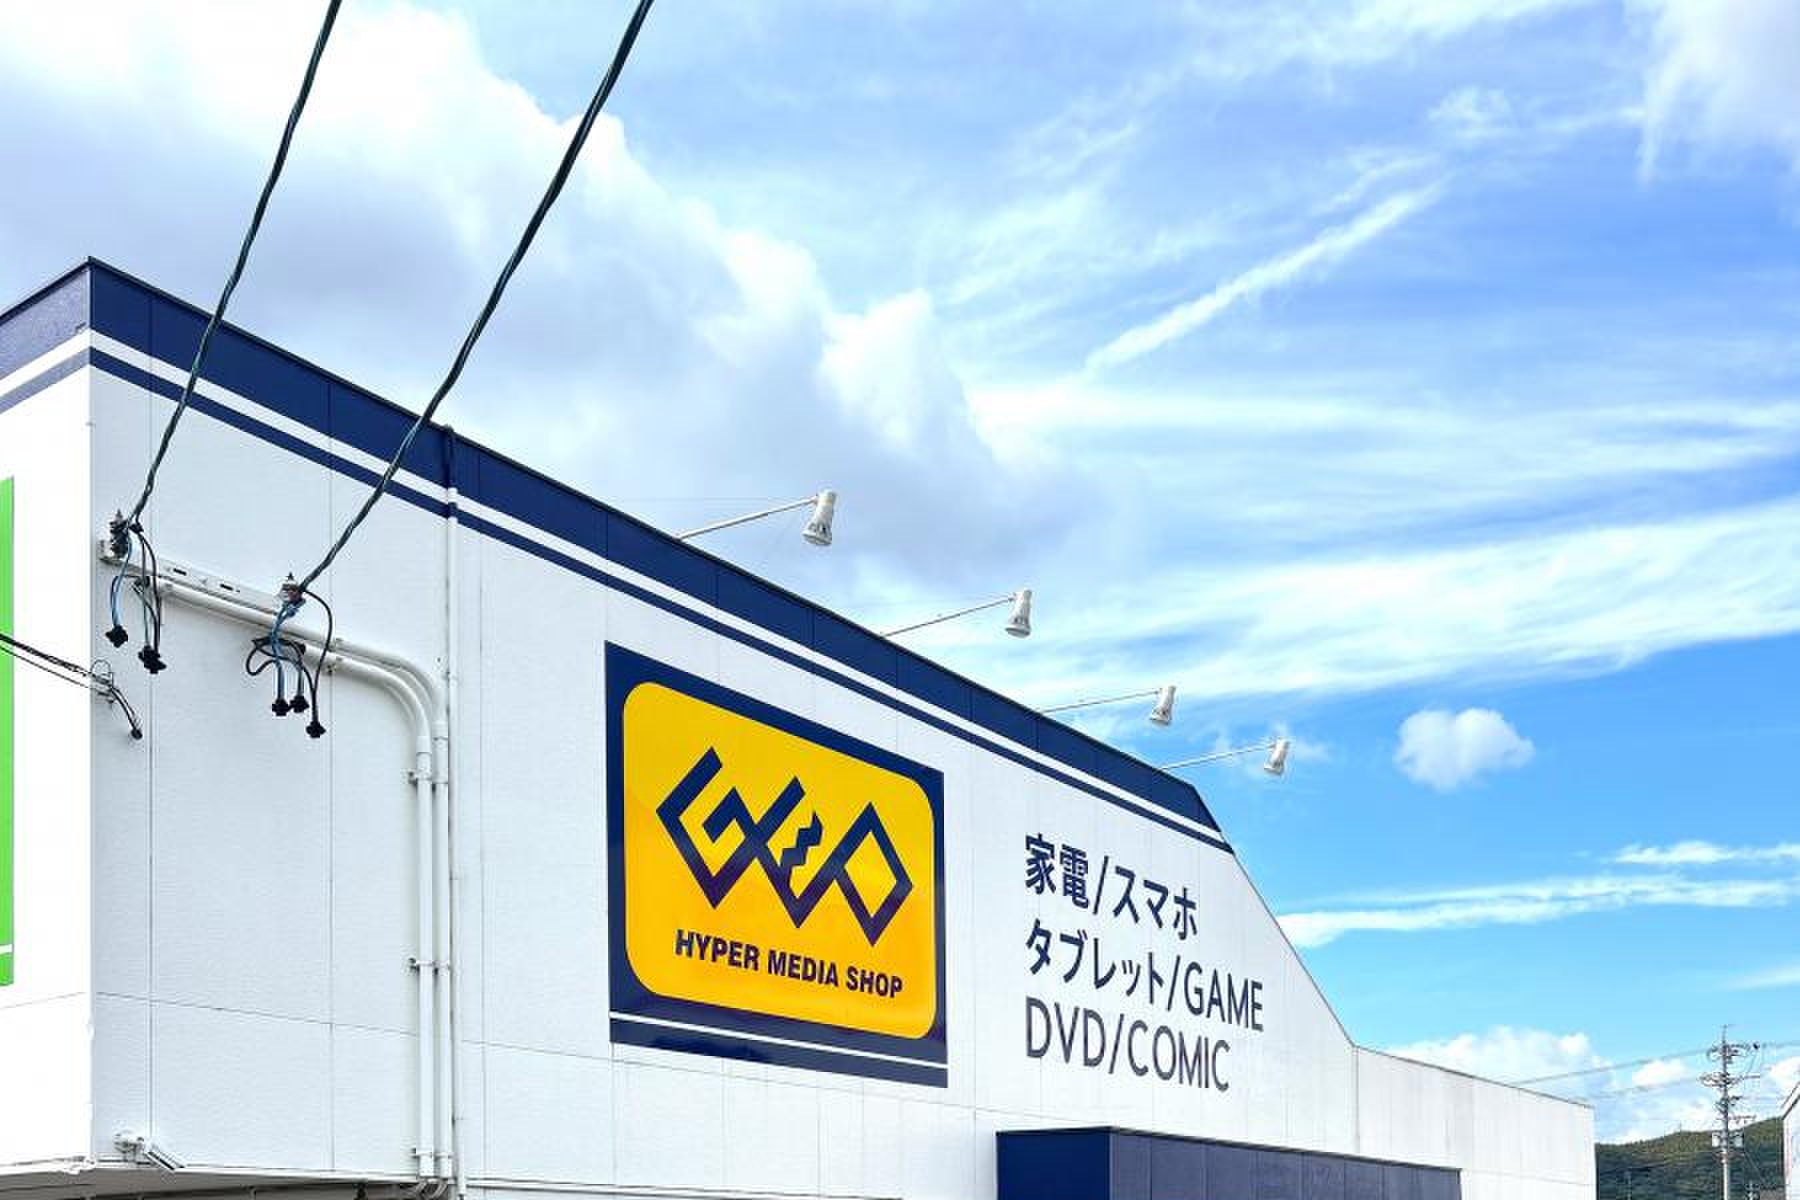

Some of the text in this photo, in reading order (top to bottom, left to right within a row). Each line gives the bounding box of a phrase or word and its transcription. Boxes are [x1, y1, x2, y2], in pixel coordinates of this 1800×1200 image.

[1025, 833, 1197, 940] 家電/スマホ
[675, 929, 903, 999] HYPER MEDIA SHOP
[1025, 918, 1263, 1032] タブレット/GAME
[1025, 996, 1230, 1092] DVD/COMIC
